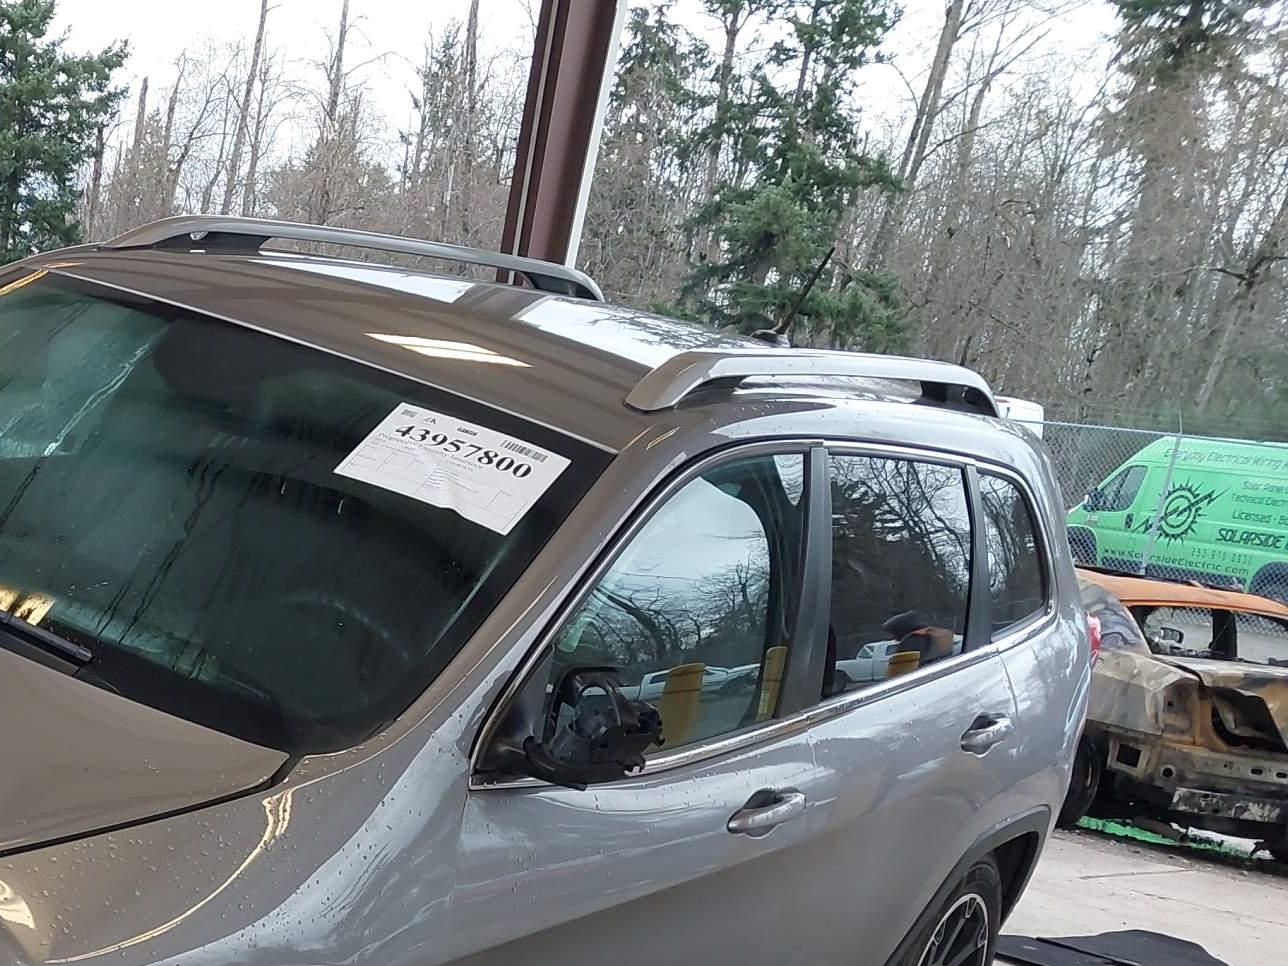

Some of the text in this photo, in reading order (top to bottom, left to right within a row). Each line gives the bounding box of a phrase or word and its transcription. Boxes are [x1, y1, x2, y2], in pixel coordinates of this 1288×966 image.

[394, 423, 532, 480] 43957800
[1232, 510, 1272, 524] Licensed
[1216, 528, 1286, 548] SOLARSIDE
